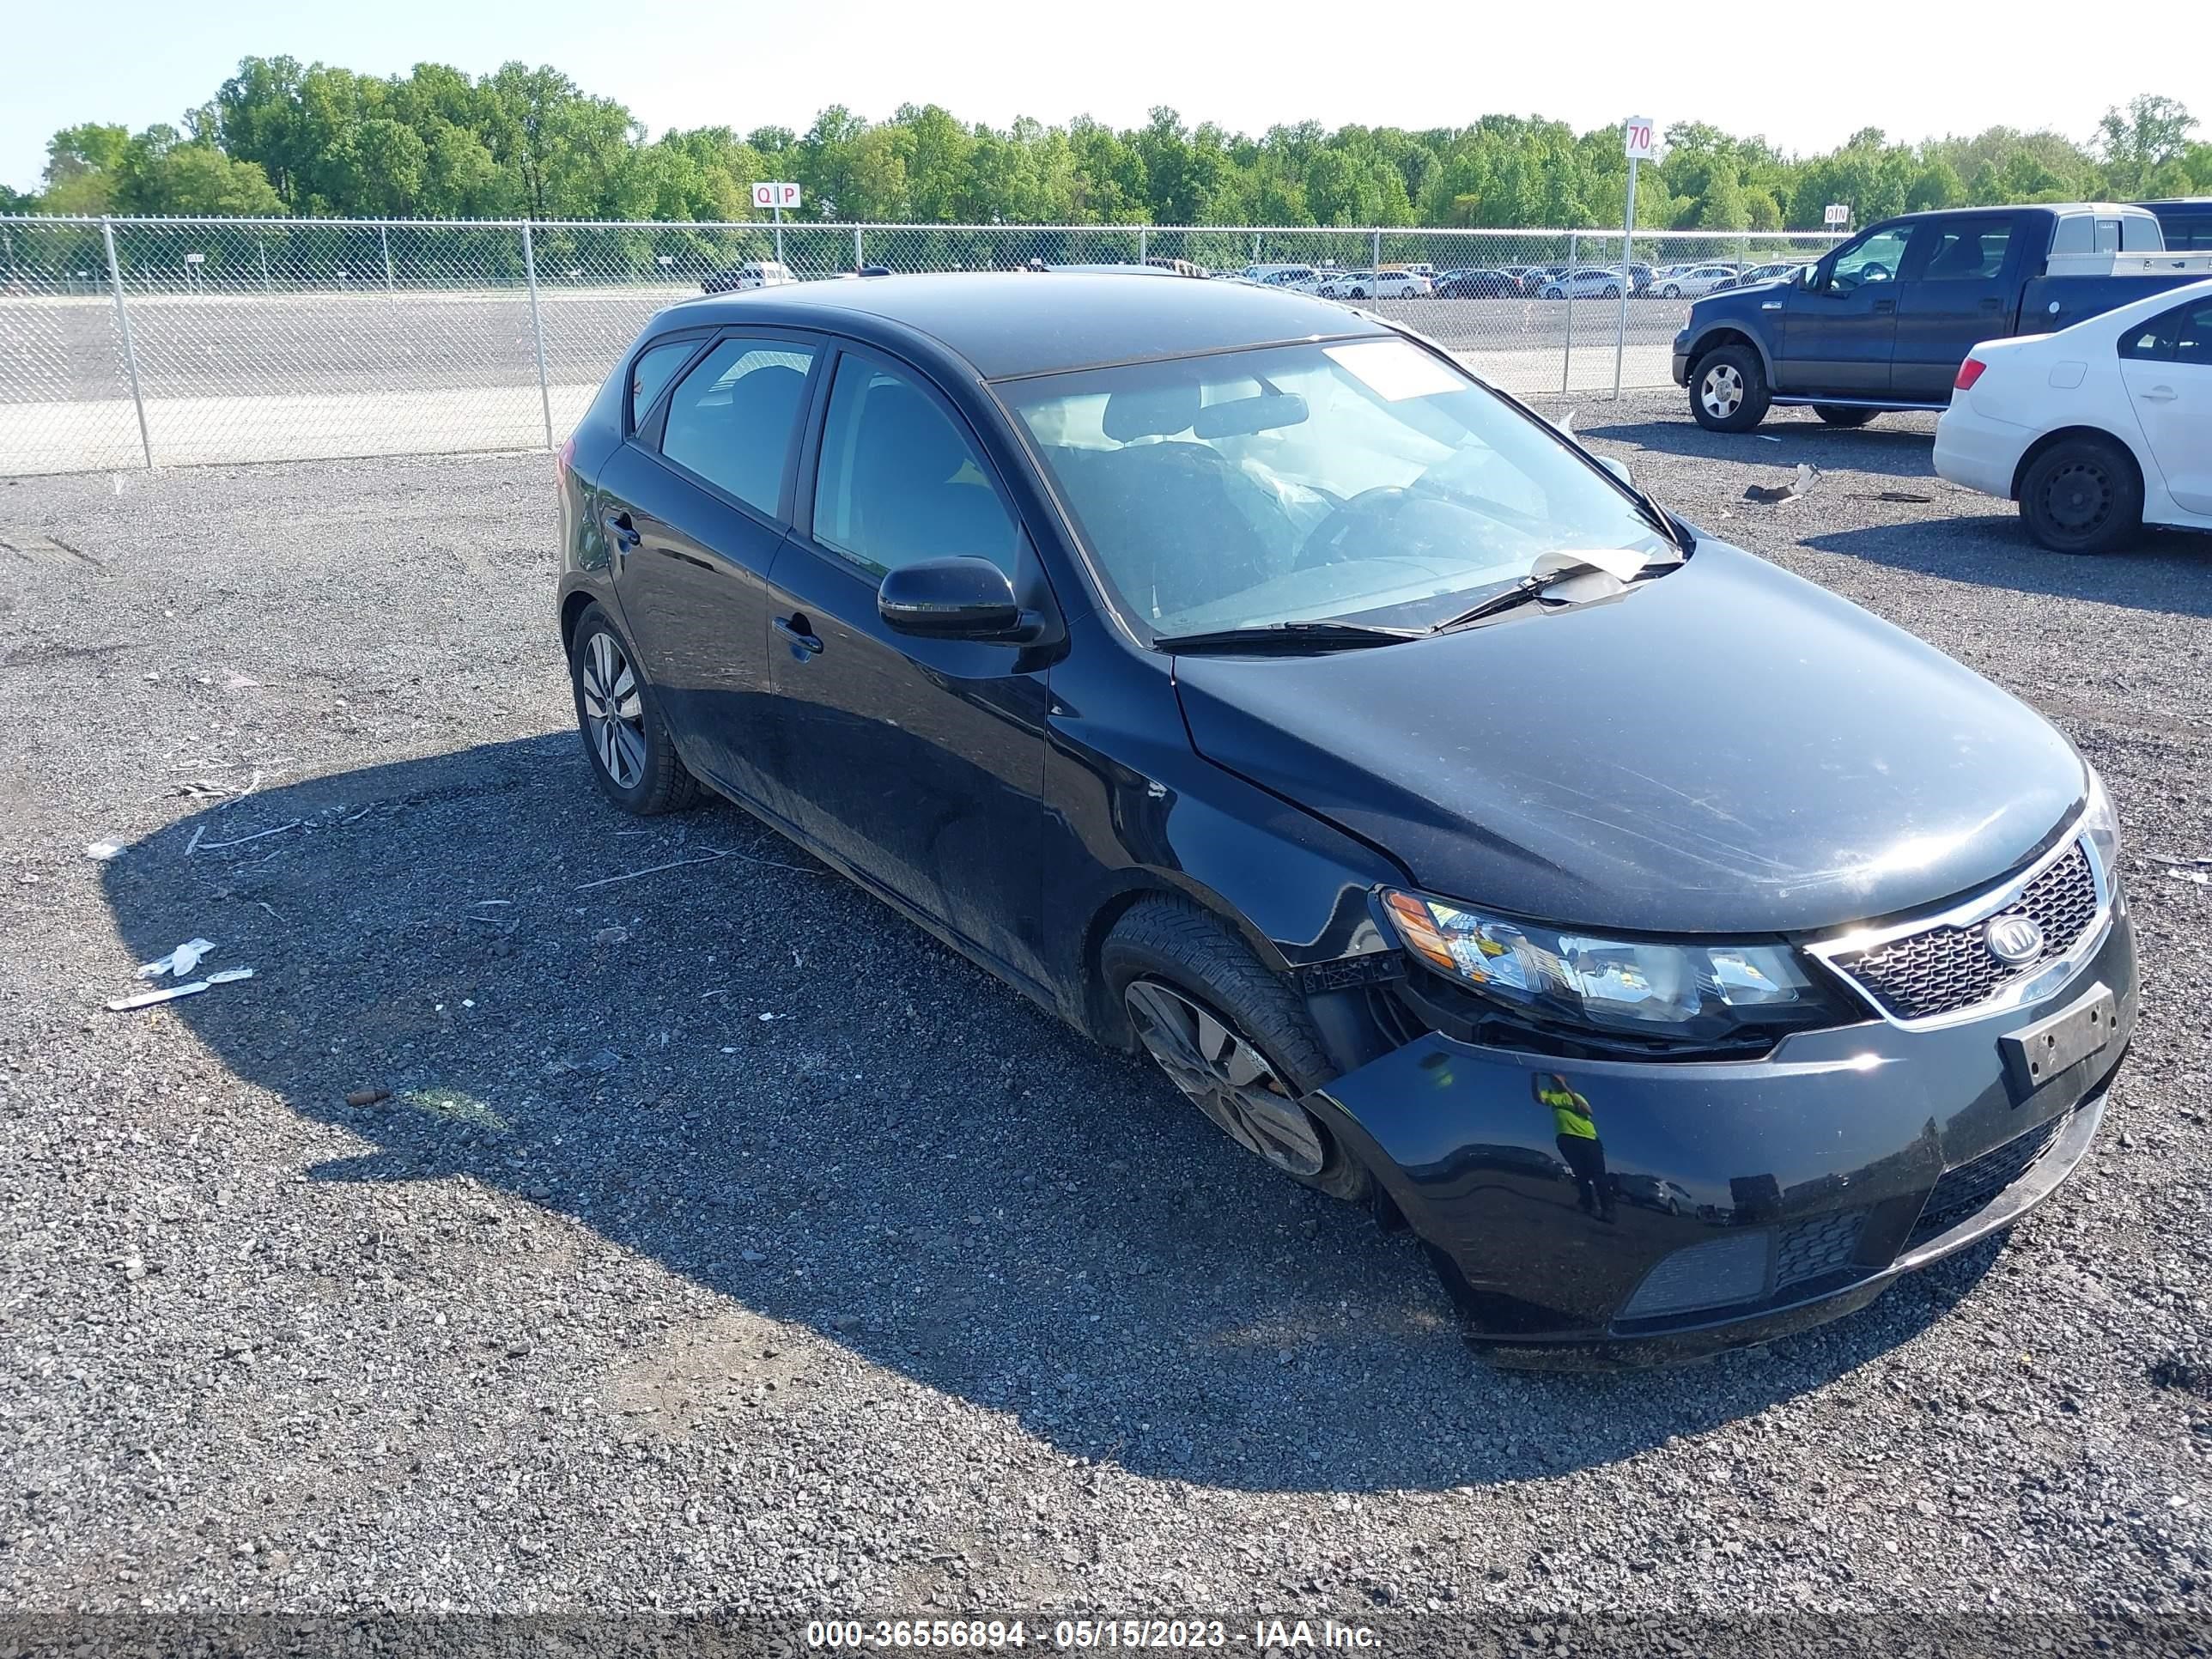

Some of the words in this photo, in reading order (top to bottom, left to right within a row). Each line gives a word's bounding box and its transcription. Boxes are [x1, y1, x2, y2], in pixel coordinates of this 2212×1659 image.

[1629, 126, 1650, 149] 70
[757, 187, 772, 203] Q
[784, 187, 794, 203] P
[1998, 923, 2039, 954] KIA
